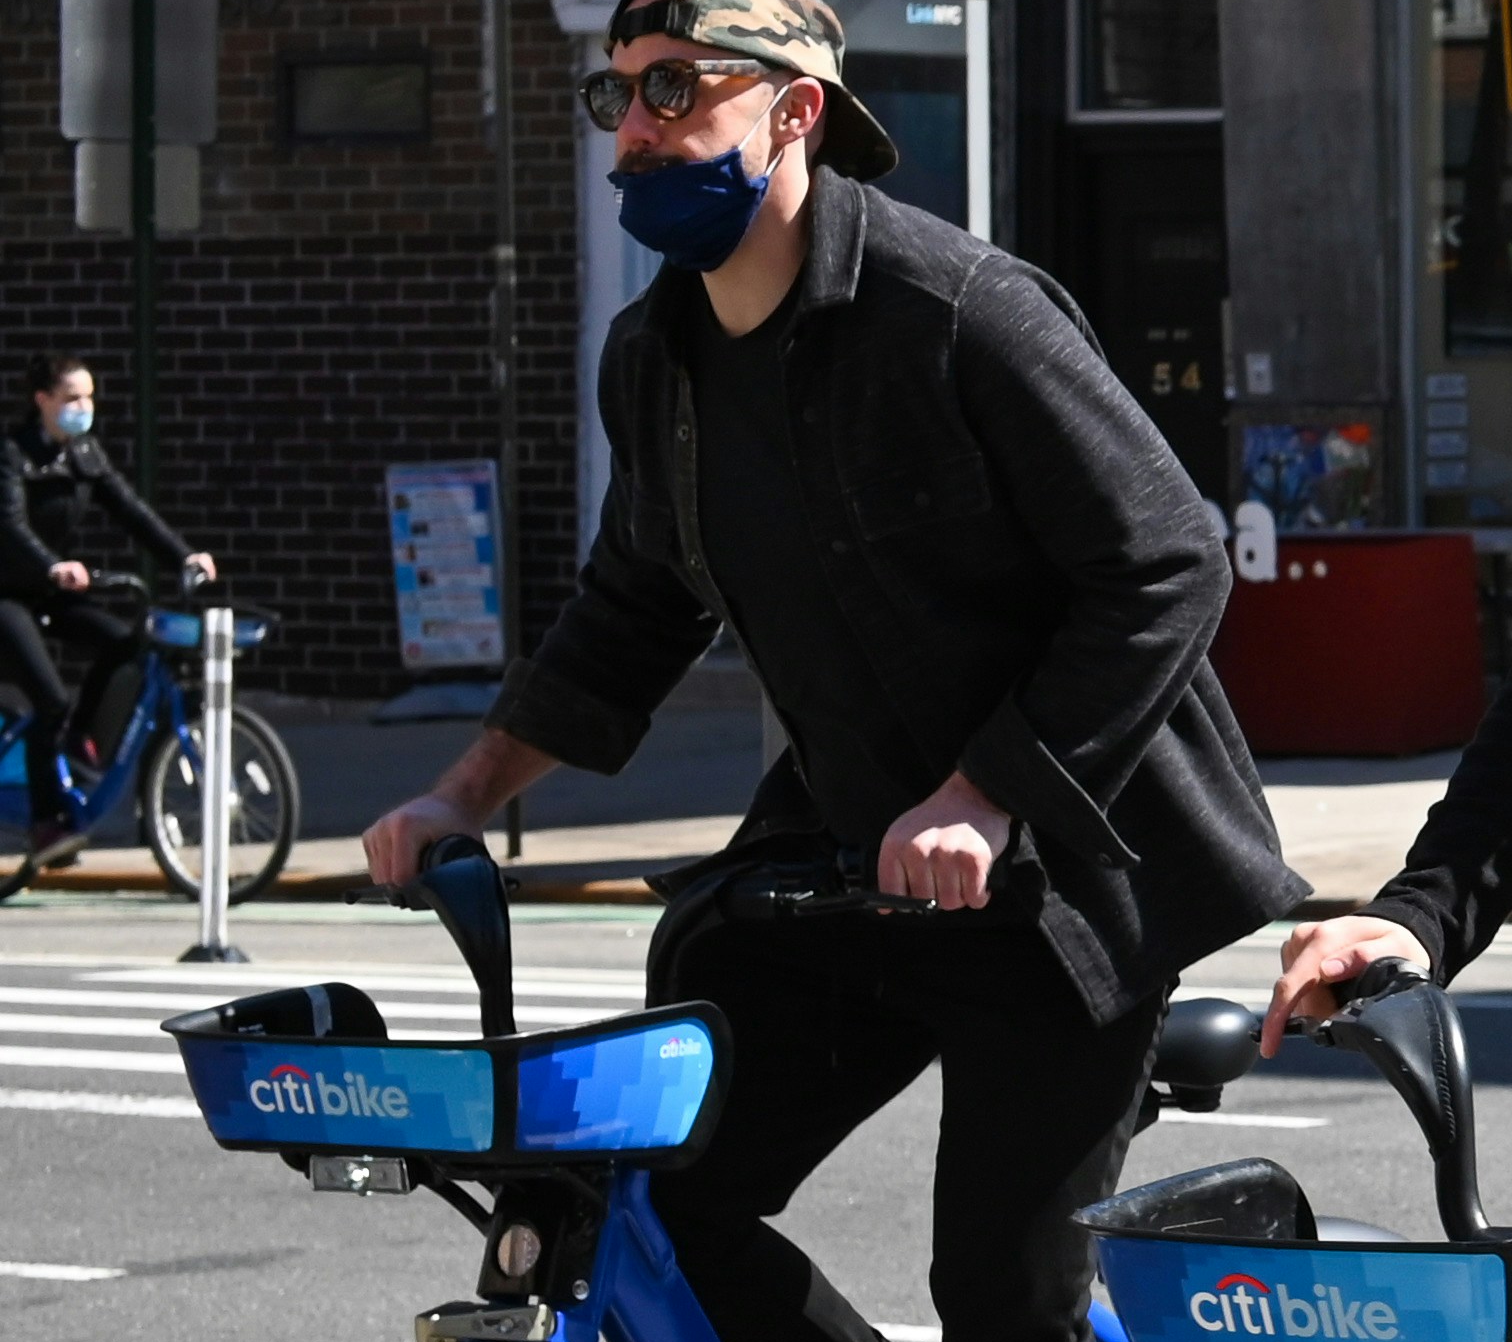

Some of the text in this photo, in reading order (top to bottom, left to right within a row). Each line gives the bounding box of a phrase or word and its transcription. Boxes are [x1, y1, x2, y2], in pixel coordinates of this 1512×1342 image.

[250, 1064, 410, 1120] citi bike
[1190, 1273, 1399, 1341] citi bike
